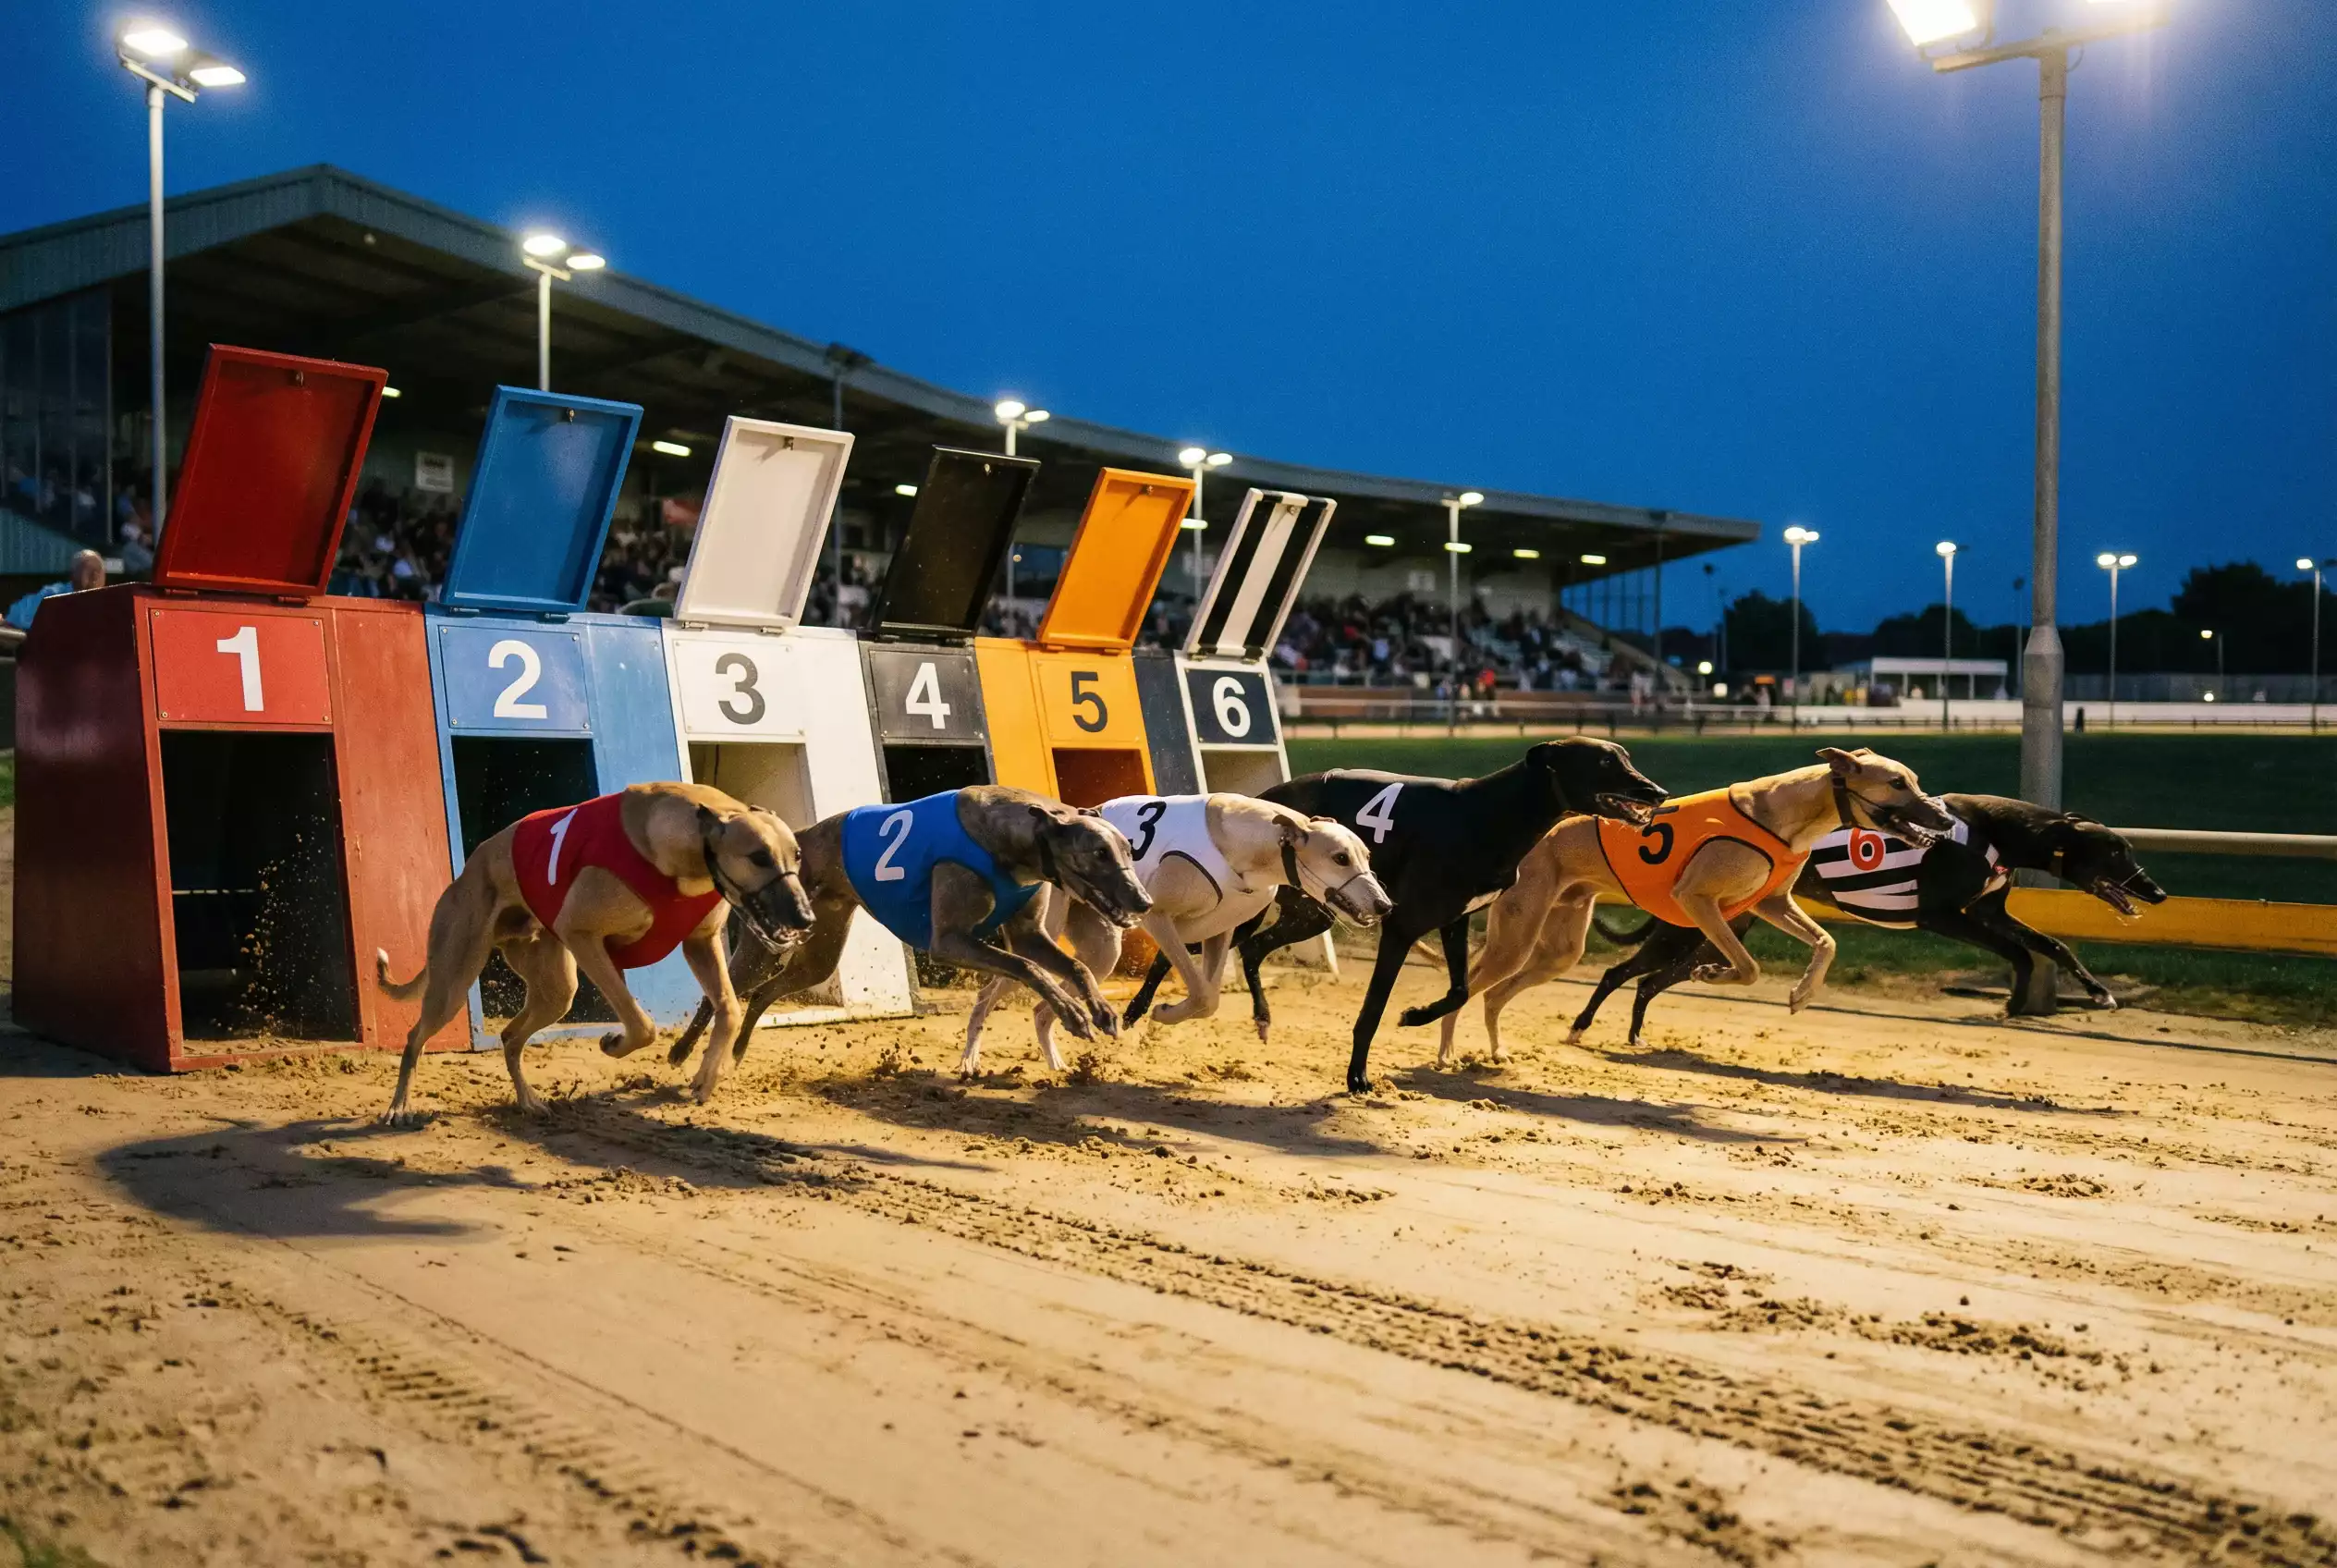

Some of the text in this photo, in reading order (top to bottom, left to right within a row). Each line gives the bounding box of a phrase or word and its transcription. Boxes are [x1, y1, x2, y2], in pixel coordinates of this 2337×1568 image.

[216, 626, 264, 711] 1
[488, 640, 547, 718] 2
[716, 653, 766, 726] 3
[906, 663, 951, 729] 4
[1071, 671, 1108, 733] 5
[1213, 677, 1251, 737] 6
[875, 810, 913, 881] 2
[1130, 802, 1167, 862] 3
[1356, 783, 1403, 844] 4
[1638, 805, 1681, 865] 5
[548, 808, 578, 885] 1
[1849, 827, 1885, 871] 6
